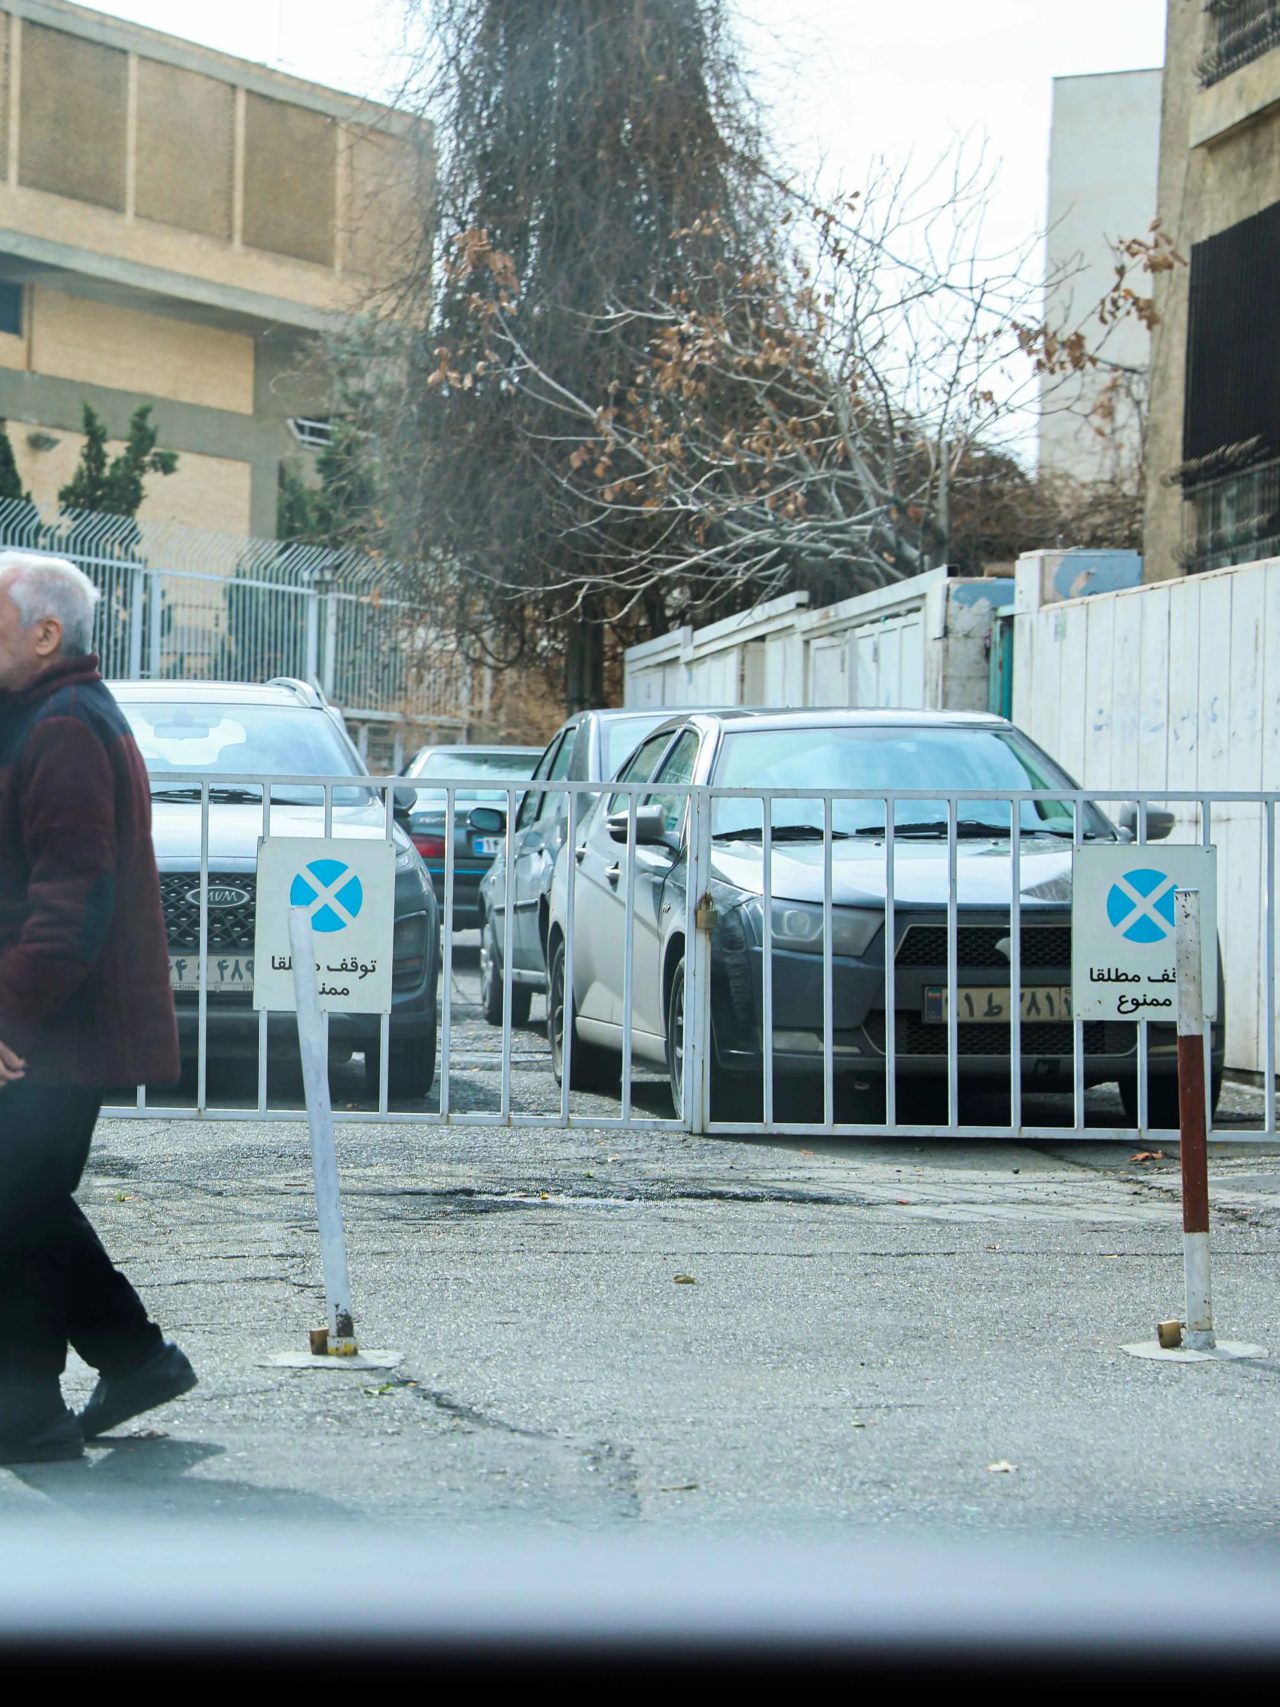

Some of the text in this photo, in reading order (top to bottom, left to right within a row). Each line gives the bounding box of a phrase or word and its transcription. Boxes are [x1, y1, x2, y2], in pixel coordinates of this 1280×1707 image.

[326, 957, 377, 980] توقف
[1089, 967, 1142, 983] مطلقا
[318, 982, 350, 996] ممن
[1117, 993, 1172, 1015] ممنوع
